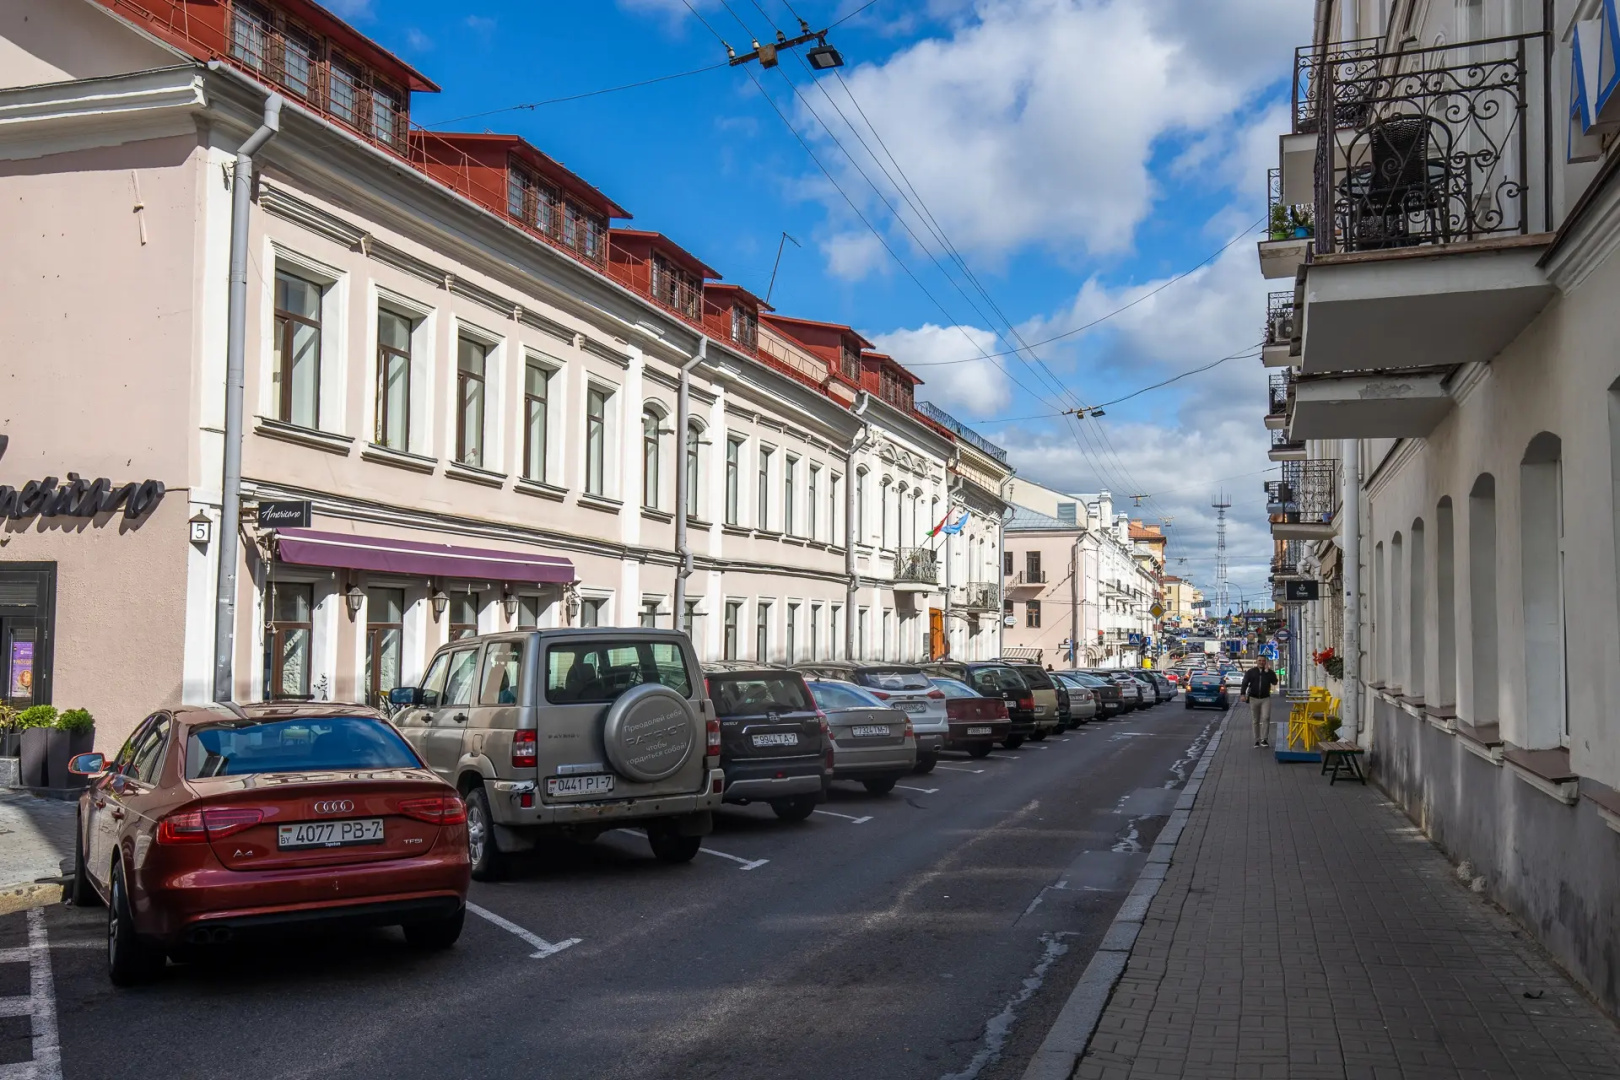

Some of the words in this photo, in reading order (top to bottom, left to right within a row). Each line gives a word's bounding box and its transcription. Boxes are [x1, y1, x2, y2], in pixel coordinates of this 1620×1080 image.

[261, 504, 301, 521] Americano
[195, 523, 206, 540] 5
[624, 714, 665, 732] Преодолей
[666, 709, 682, 719] себя
[626, 751, 663, 765] гордиться
[664, 742, 687, 755] собой!
[645, 741, 667, 751] чтобы
[558, 779, 582, 791] 0441
[280, 836, 291, 845] BY
[295, 824, 335, 843] 4077
[341, 821, 381, 840] PB-7
[233, 849, 254, 858] A4
